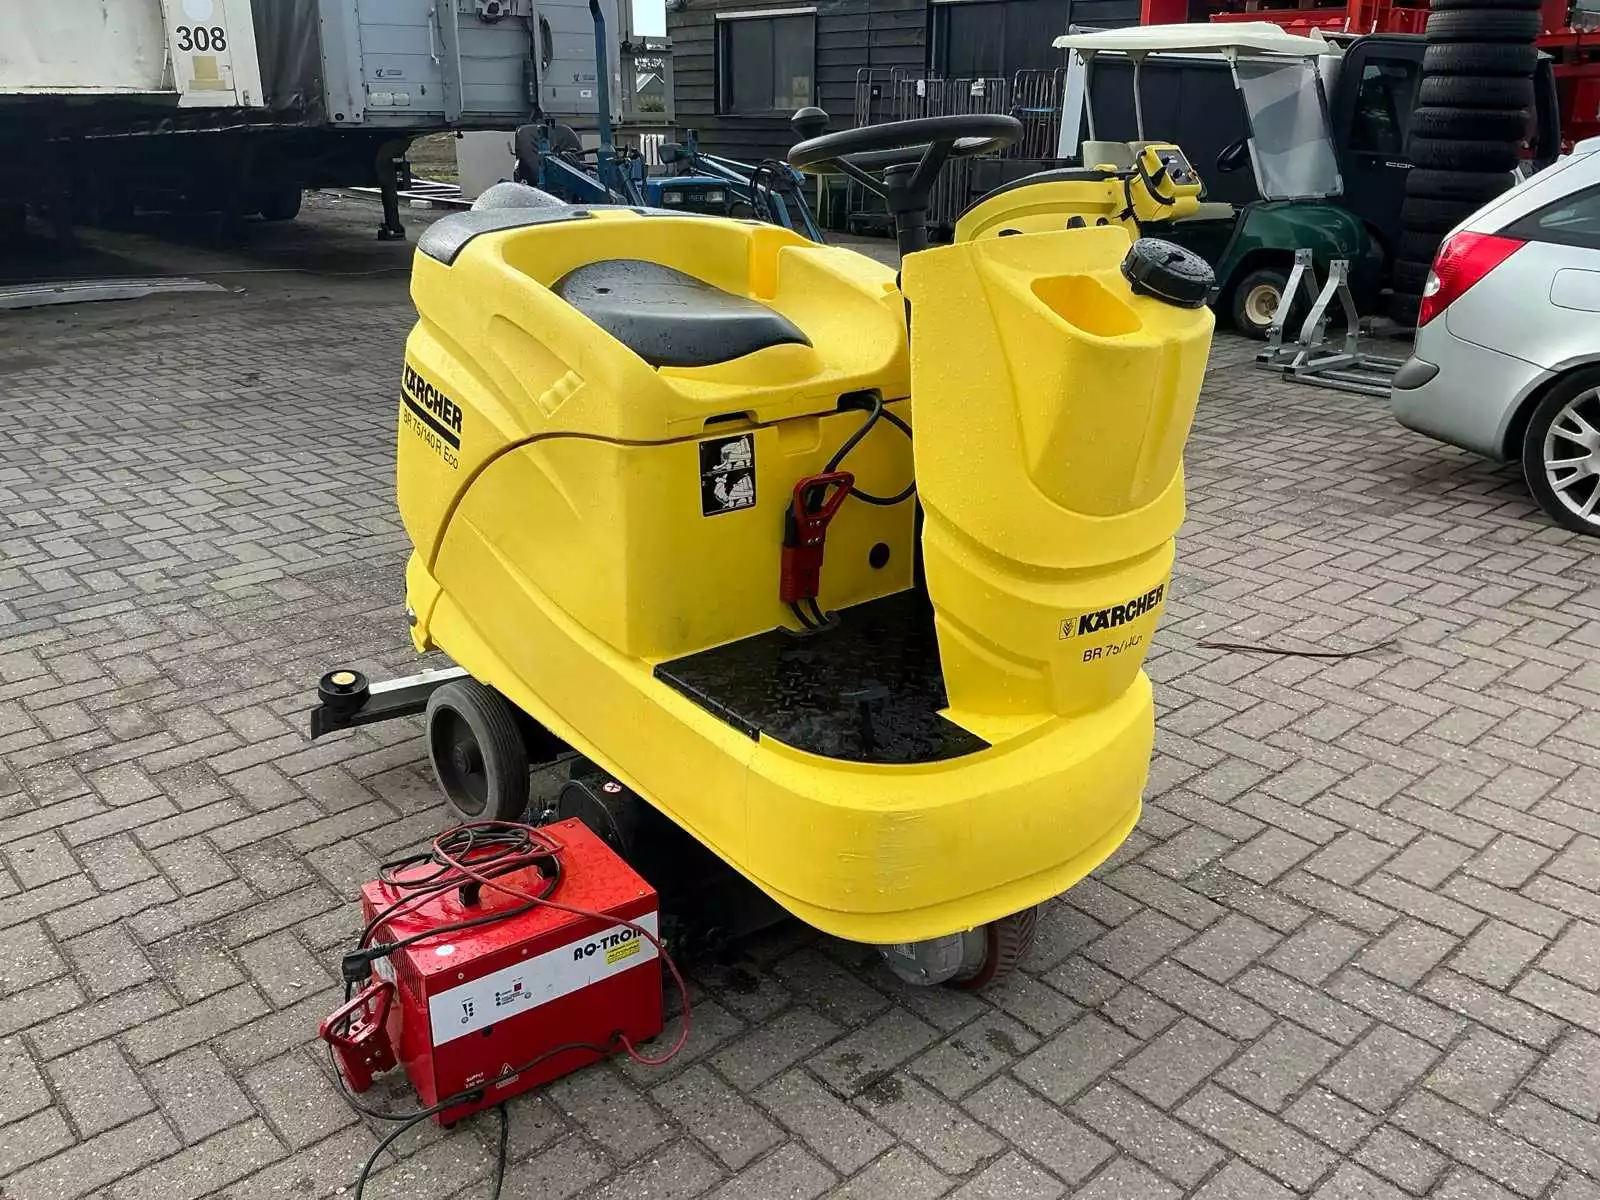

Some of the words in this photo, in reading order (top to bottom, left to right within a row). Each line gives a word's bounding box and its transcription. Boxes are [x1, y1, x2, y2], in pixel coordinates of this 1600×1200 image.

[176, 25, 226, 51] 308
[1078, 584, 1165, 636] KÄRCHER
[1082, 647, 1102, 662] BR
